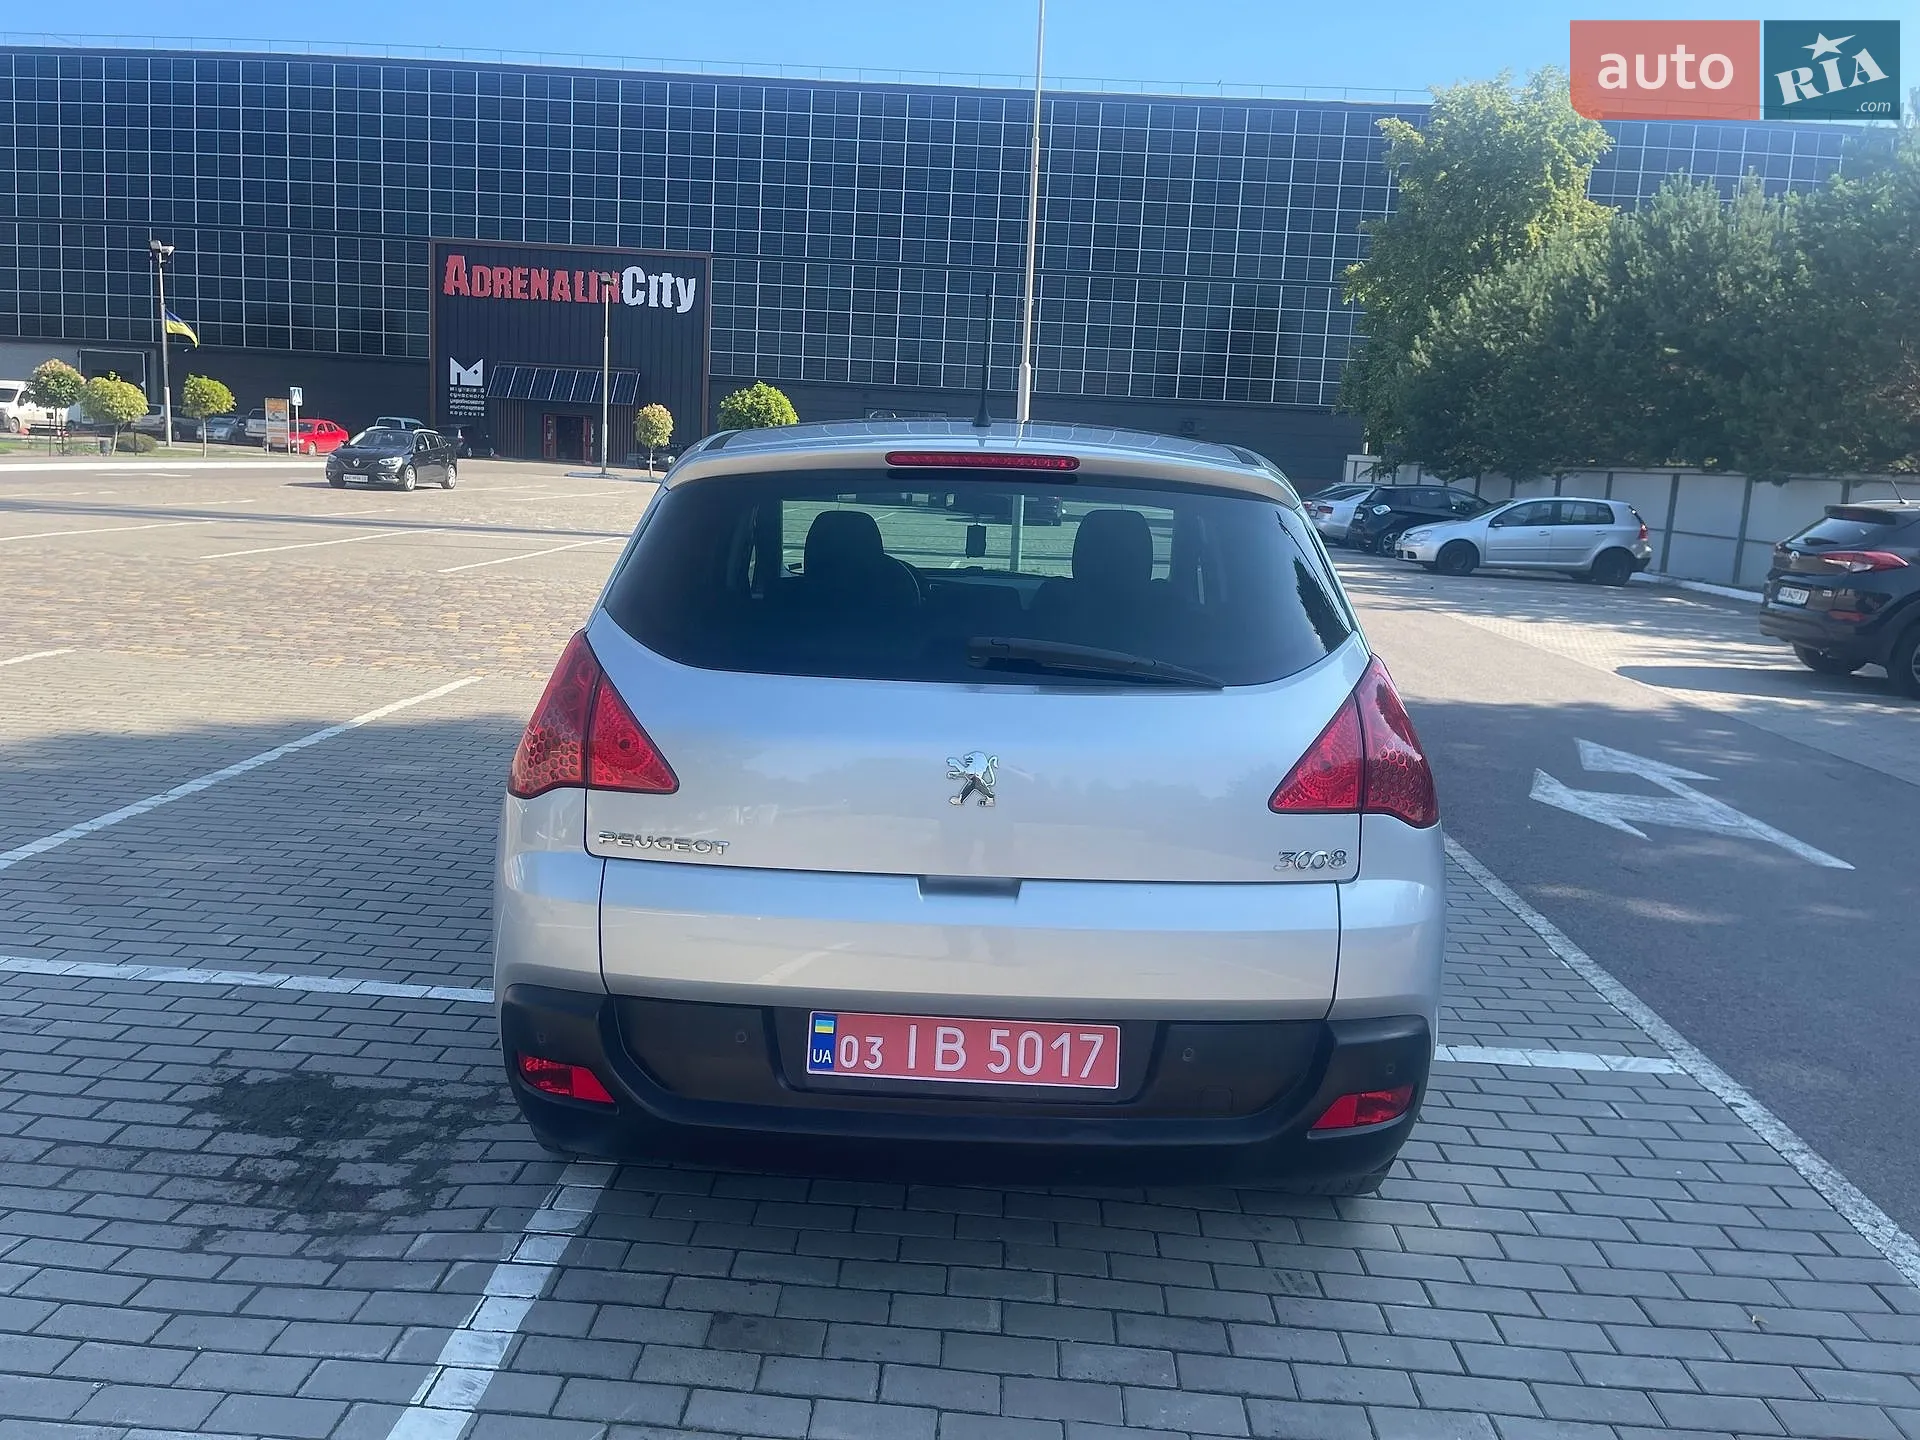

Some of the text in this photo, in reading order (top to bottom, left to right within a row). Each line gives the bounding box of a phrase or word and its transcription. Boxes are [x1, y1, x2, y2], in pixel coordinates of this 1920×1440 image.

[599, 830, 730, 855] PEUGEOT
[1273, 848, 1347, 871] 3008
[812, 1048, 833, 1065] UA
[839, 1035, 884, 1071] 03
[987, 1028, 1104, 1079] 5017
